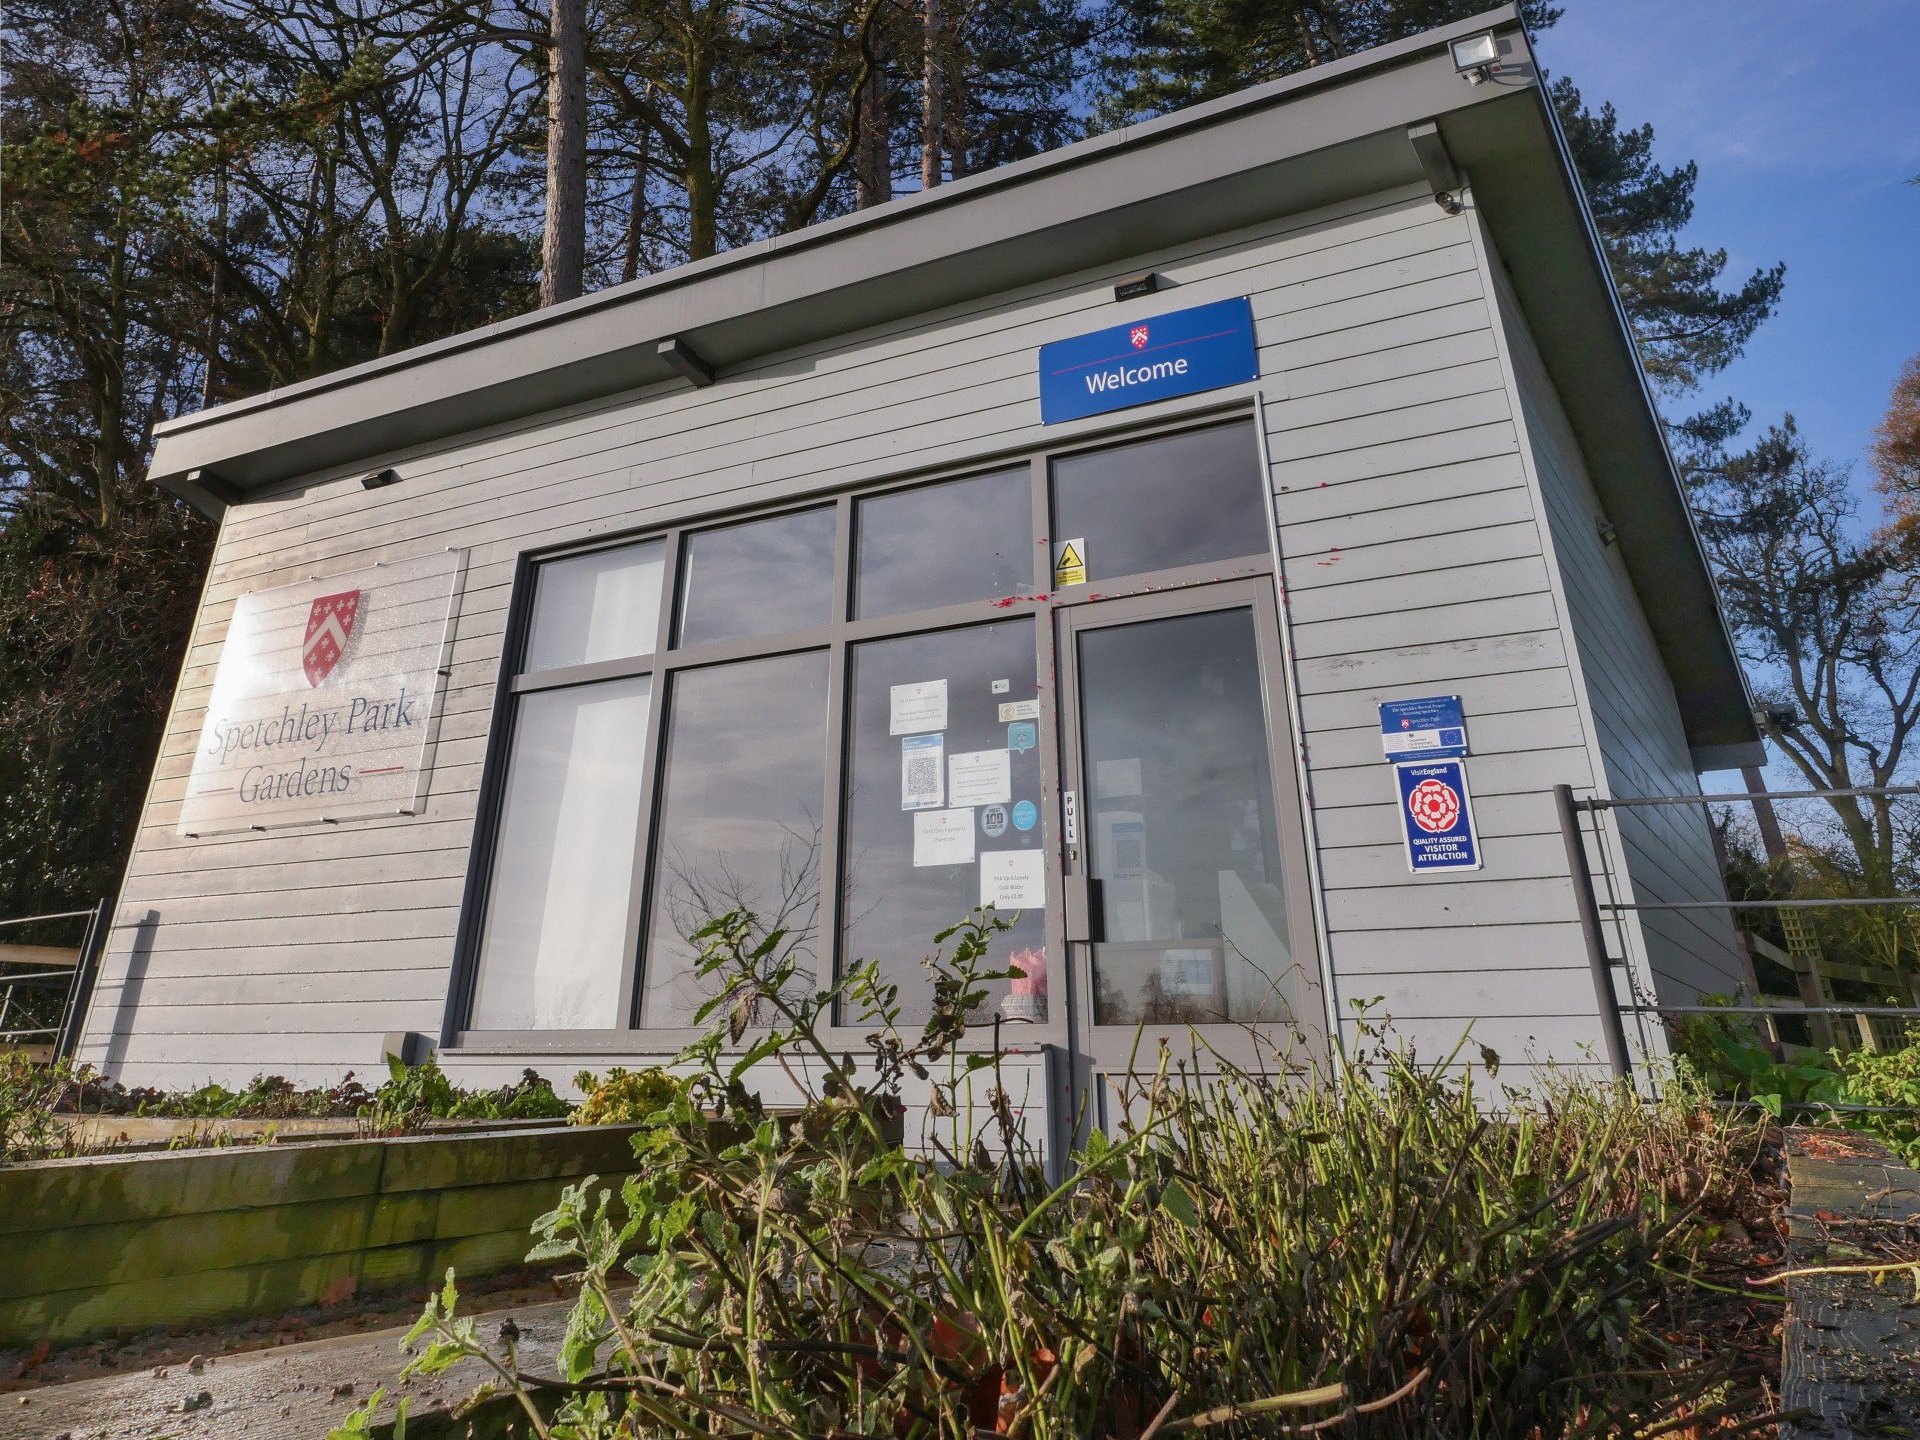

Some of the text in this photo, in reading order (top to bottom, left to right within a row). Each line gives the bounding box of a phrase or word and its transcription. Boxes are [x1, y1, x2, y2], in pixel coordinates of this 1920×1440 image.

[1085, 358, 1187, 394] Welcome
[208, 688, 415, 765] Spetchley Park
[1411, 767, 1447, 776] VisitEngland
[239, 757, 352, 803] Gardens
[986, 812, 1003, 824] 100
[1439, 835, 1467, 843] ASSURED
[1424, 843, 1457, 852] VISITOR
[1418, 852, 1467, 862] ATTRACTION
